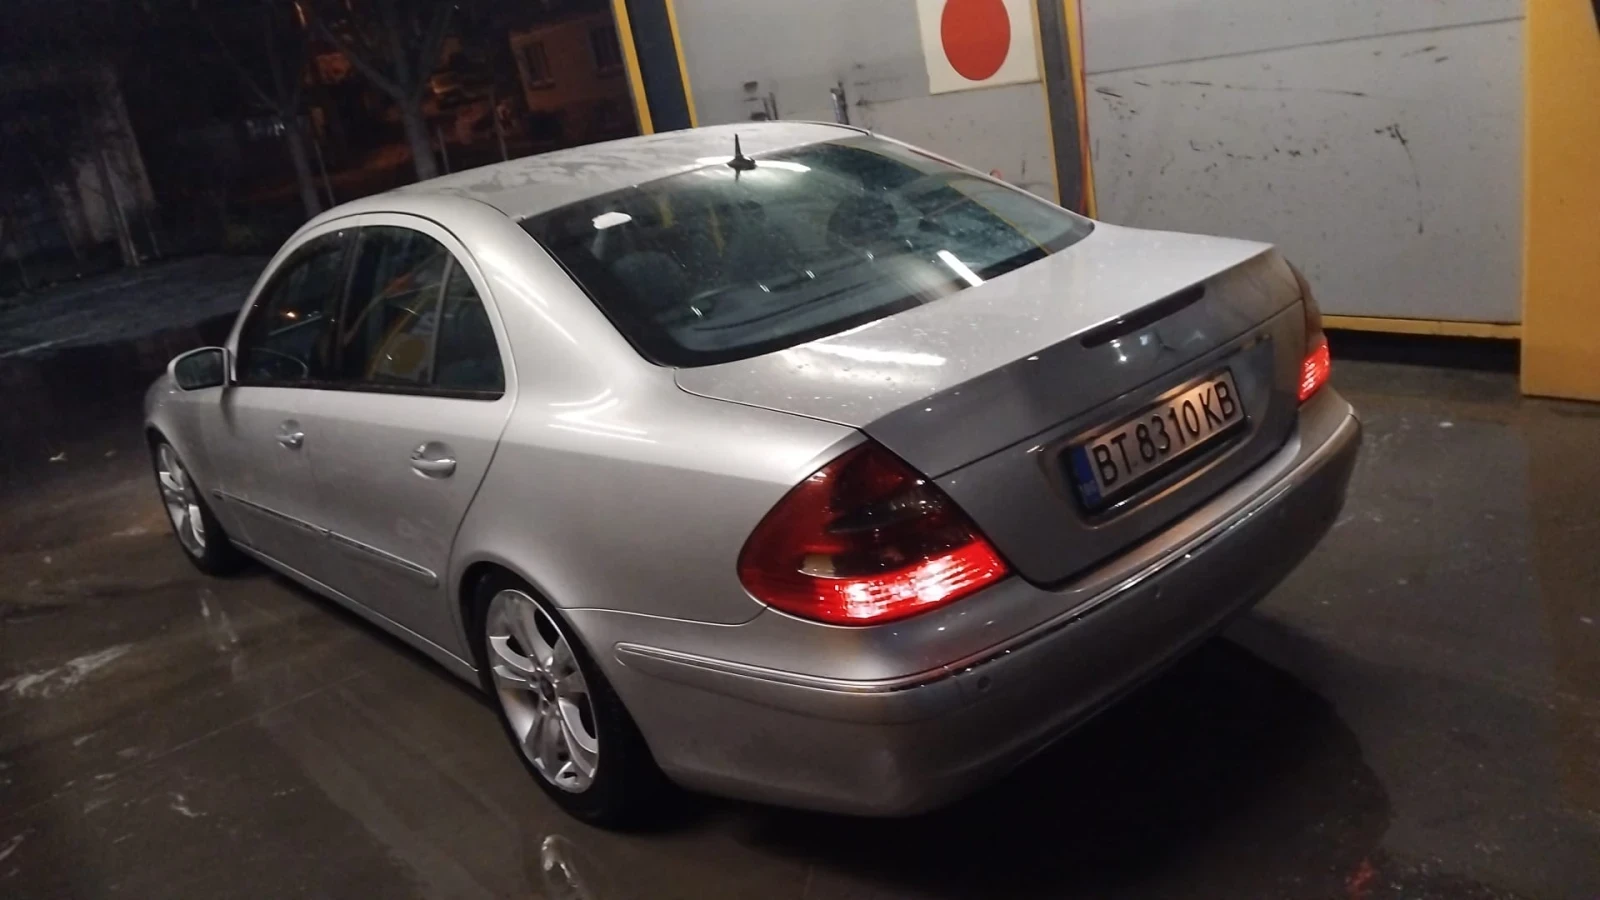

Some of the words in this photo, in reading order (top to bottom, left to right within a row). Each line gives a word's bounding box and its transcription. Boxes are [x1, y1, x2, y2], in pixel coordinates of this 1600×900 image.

[1092, 433, 1131, 487] BT
[1135, 400, 1200, 464] 8310
[1199, 381, 1236, 431] KB
